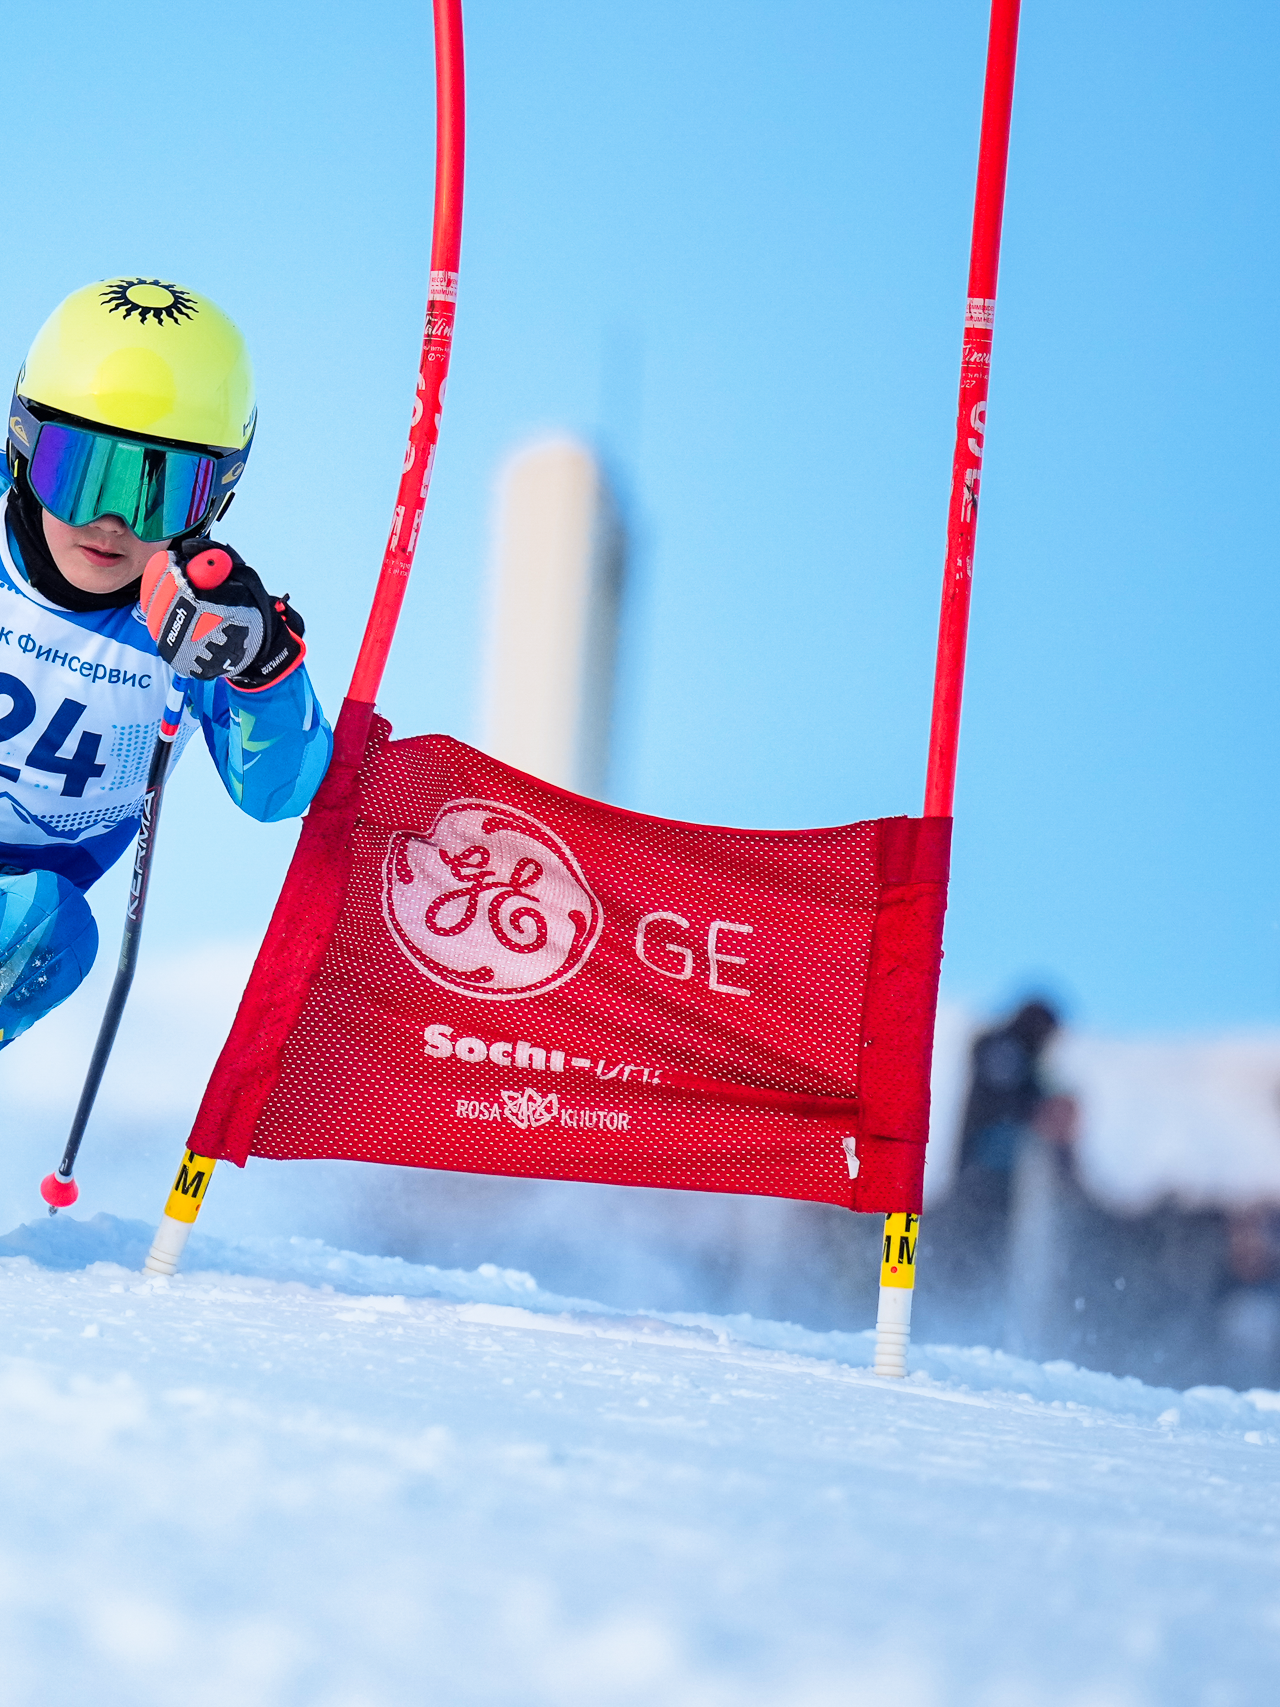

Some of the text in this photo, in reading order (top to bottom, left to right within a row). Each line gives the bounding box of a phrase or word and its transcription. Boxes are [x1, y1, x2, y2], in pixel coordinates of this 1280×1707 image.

[166, 606, 187, 647] reusch
[17, 633, 152, 689] Финсервис
[634, 910, 754, 998] GE
[456, 1099, 630, 1131] ROSA KHUTOR
